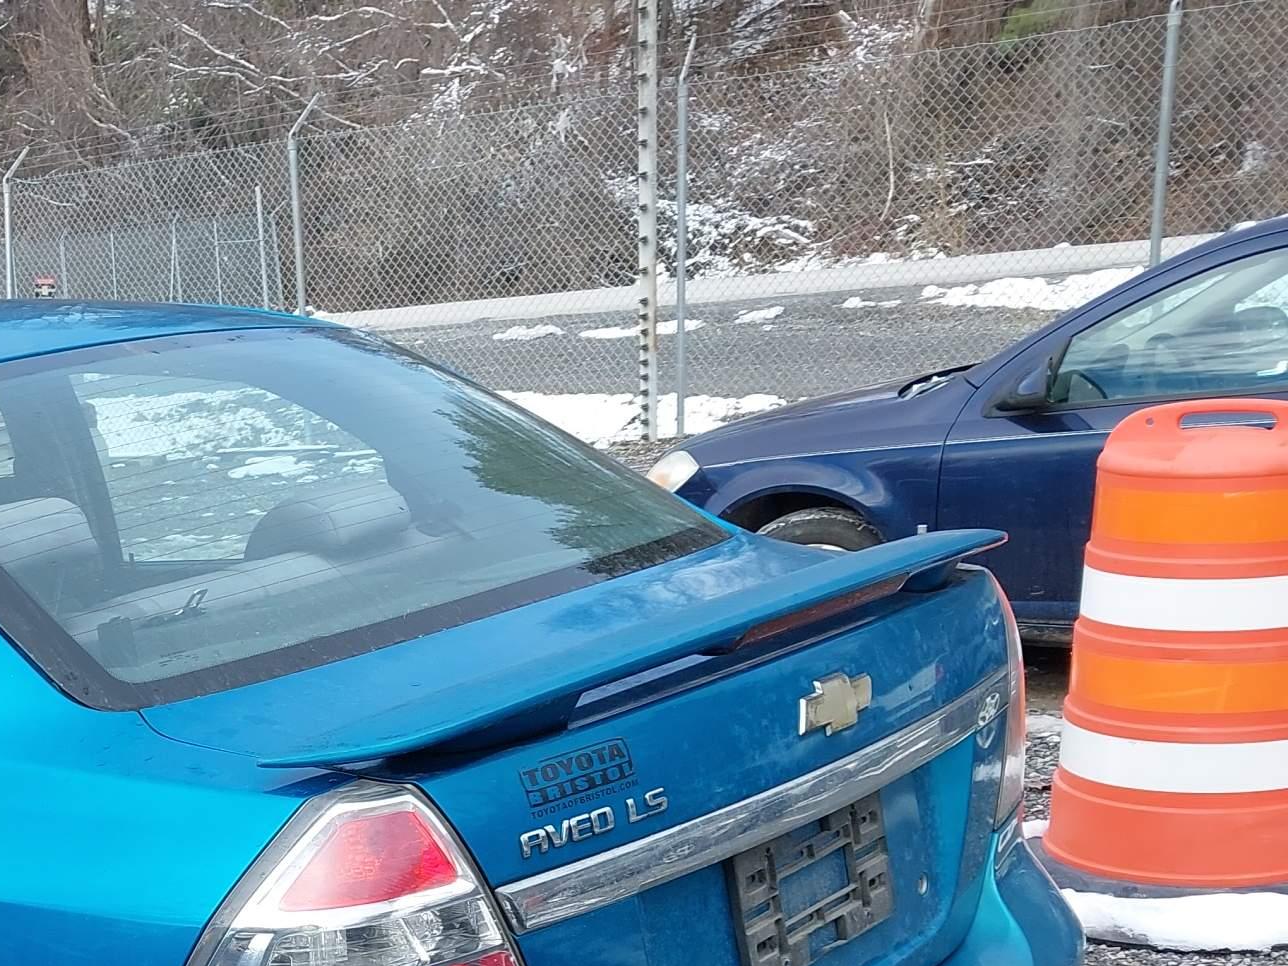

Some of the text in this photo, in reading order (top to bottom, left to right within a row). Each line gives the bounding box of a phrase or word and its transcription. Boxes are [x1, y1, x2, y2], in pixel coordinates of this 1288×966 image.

[523, 742, 626, 787] TOYOTA
[527, 762, 633, 804] BRISTOL
[530, 778, 639, 819] TOYOTAOFBRISTOL.COM
[520, 787, 668, 859] AVEO LS
